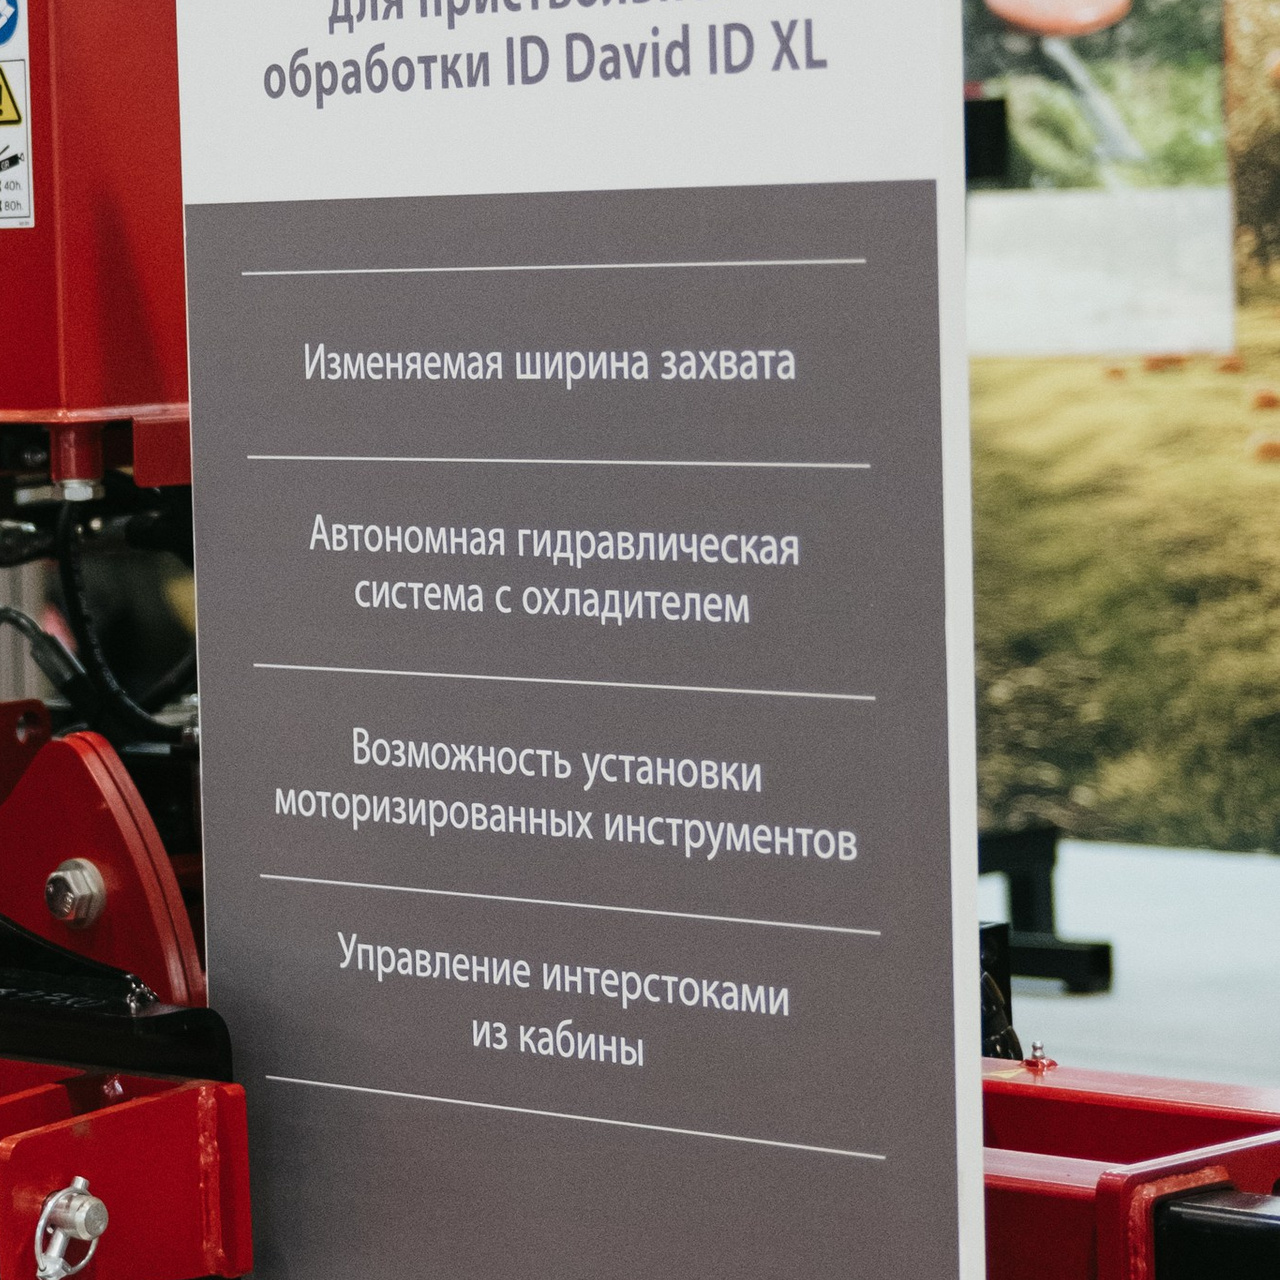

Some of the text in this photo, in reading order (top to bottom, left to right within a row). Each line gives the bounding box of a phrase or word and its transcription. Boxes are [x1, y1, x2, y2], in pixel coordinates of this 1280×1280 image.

[263, 18, 828, 110] обработки ID David ID XL
[304, 342, 796, 391] Изменяемая ширина захвата
[309, 513, 800, 569] Автономная гидравлическая
[354, 579, 750, 626] система с охладителем
[352, 726, 762, 793] Возможность установки
[275, 785, 858, 861] моторизированных инструментов
[337, 931, 790, 1017] Управление интерстоками
[472, 1018, 644, 1067] из кабины
